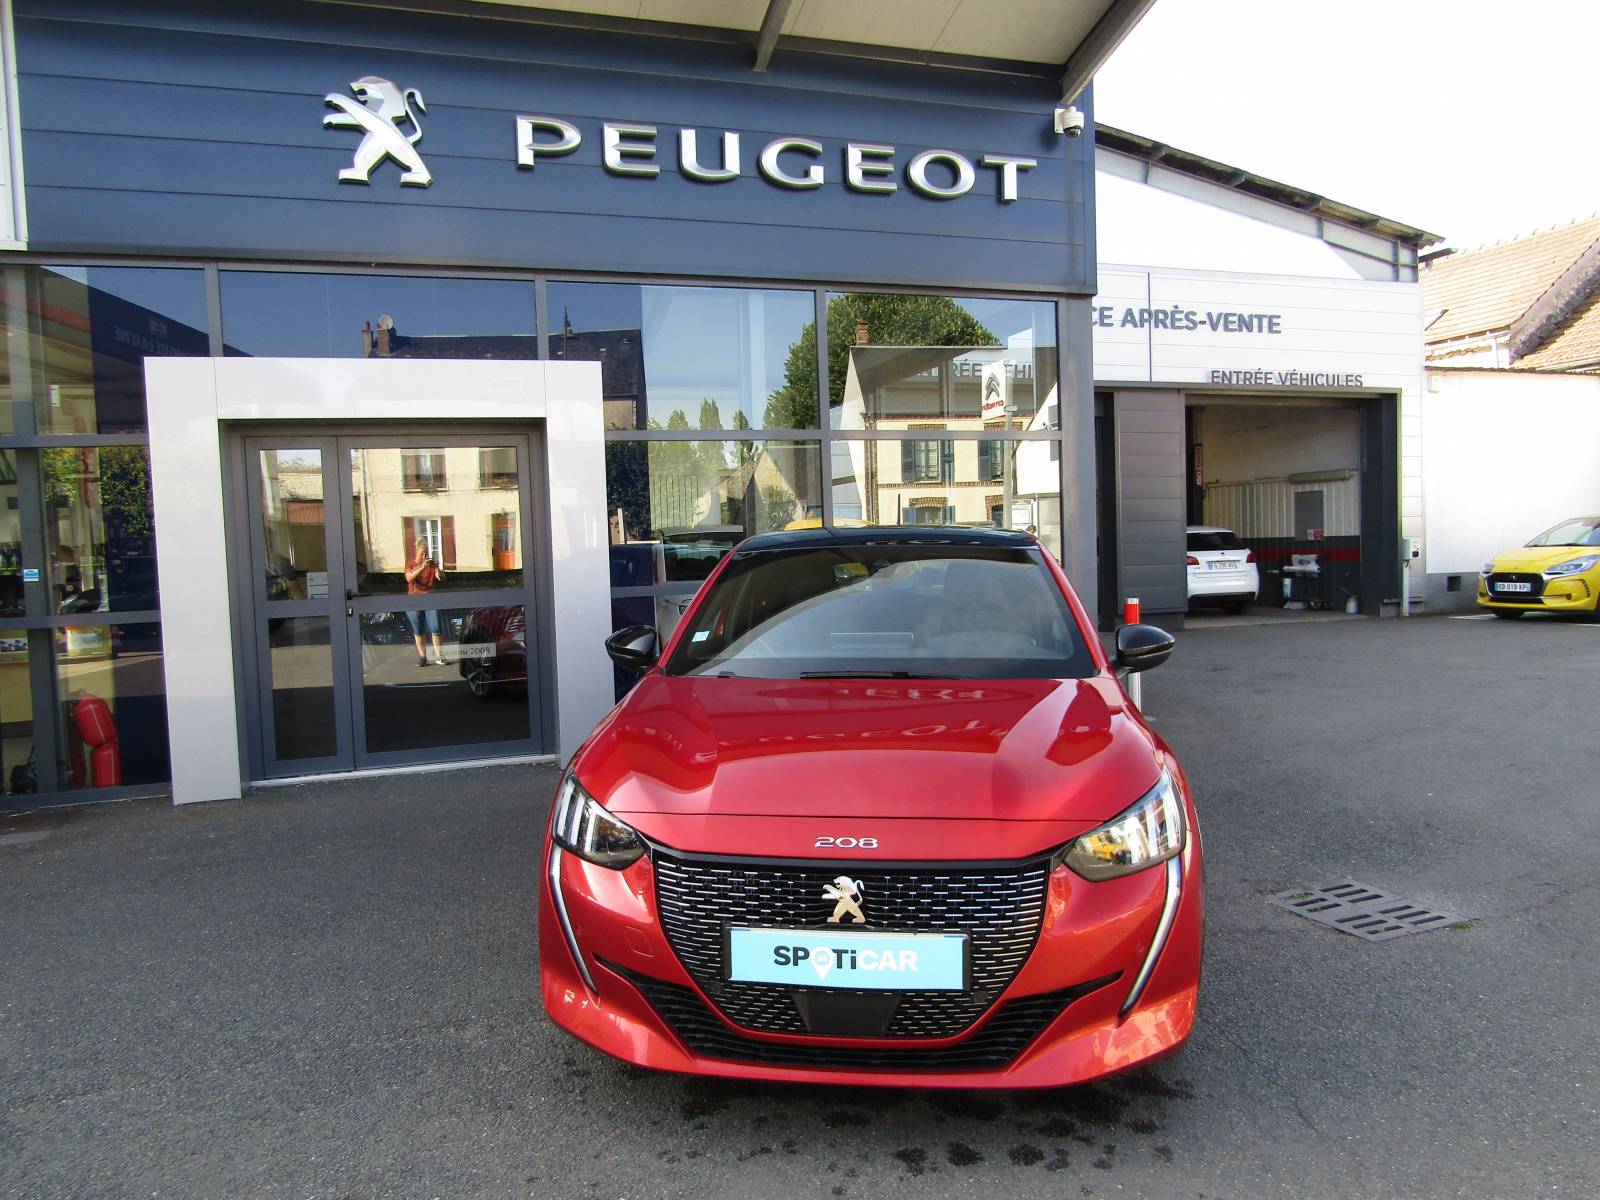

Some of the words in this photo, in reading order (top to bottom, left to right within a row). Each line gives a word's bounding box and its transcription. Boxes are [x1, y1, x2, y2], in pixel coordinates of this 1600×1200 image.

[515, 114, 1038, 202] PEUGEOT
[1120, 304, 1282, 334] APRÈS-VENTE
[1211, 368, 1273, 384] ENTRÉE
[1278, 369, 1363, 387] VÉHICULES
[814, 836, 879, 849] 208
